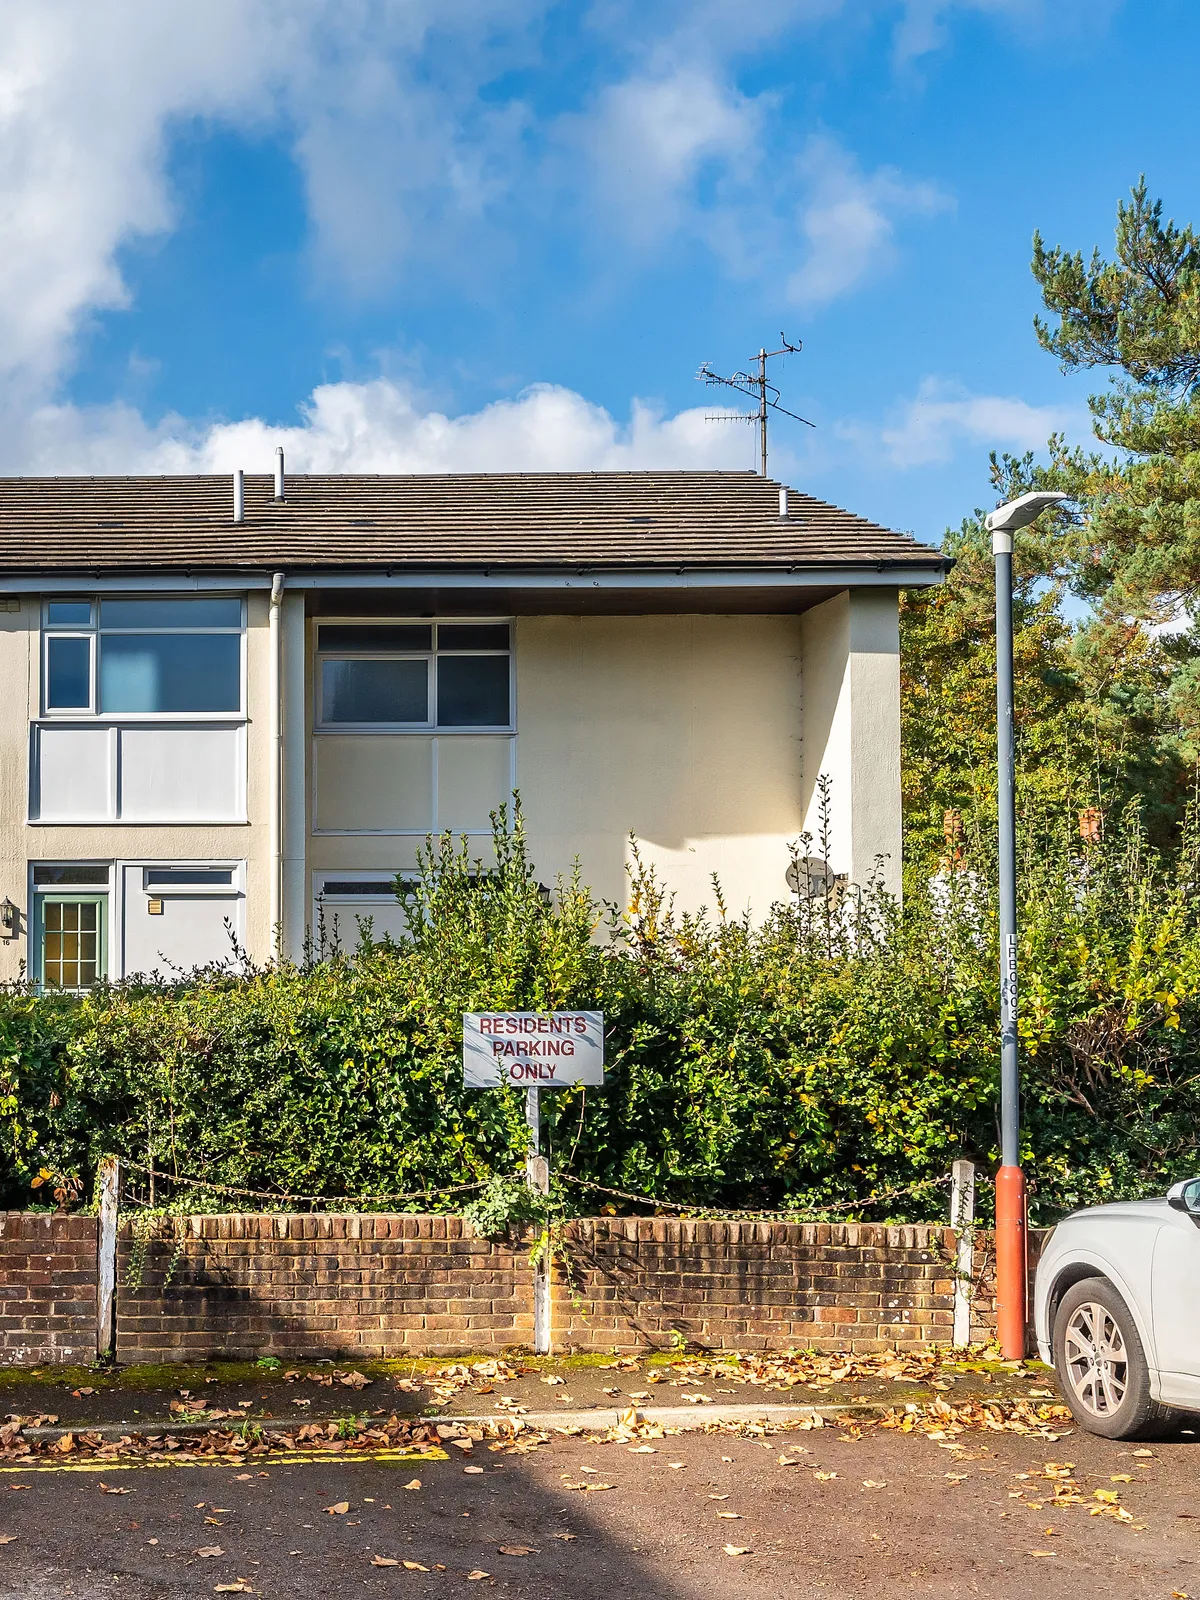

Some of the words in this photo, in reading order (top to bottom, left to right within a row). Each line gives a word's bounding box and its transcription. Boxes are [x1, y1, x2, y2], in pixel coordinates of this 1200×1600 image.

[480, 1016, 587, 1034] RESIDENTS
[493, 1040, 575, 1056] PARKING
[510, 1064, 556, 1080] ONLY
